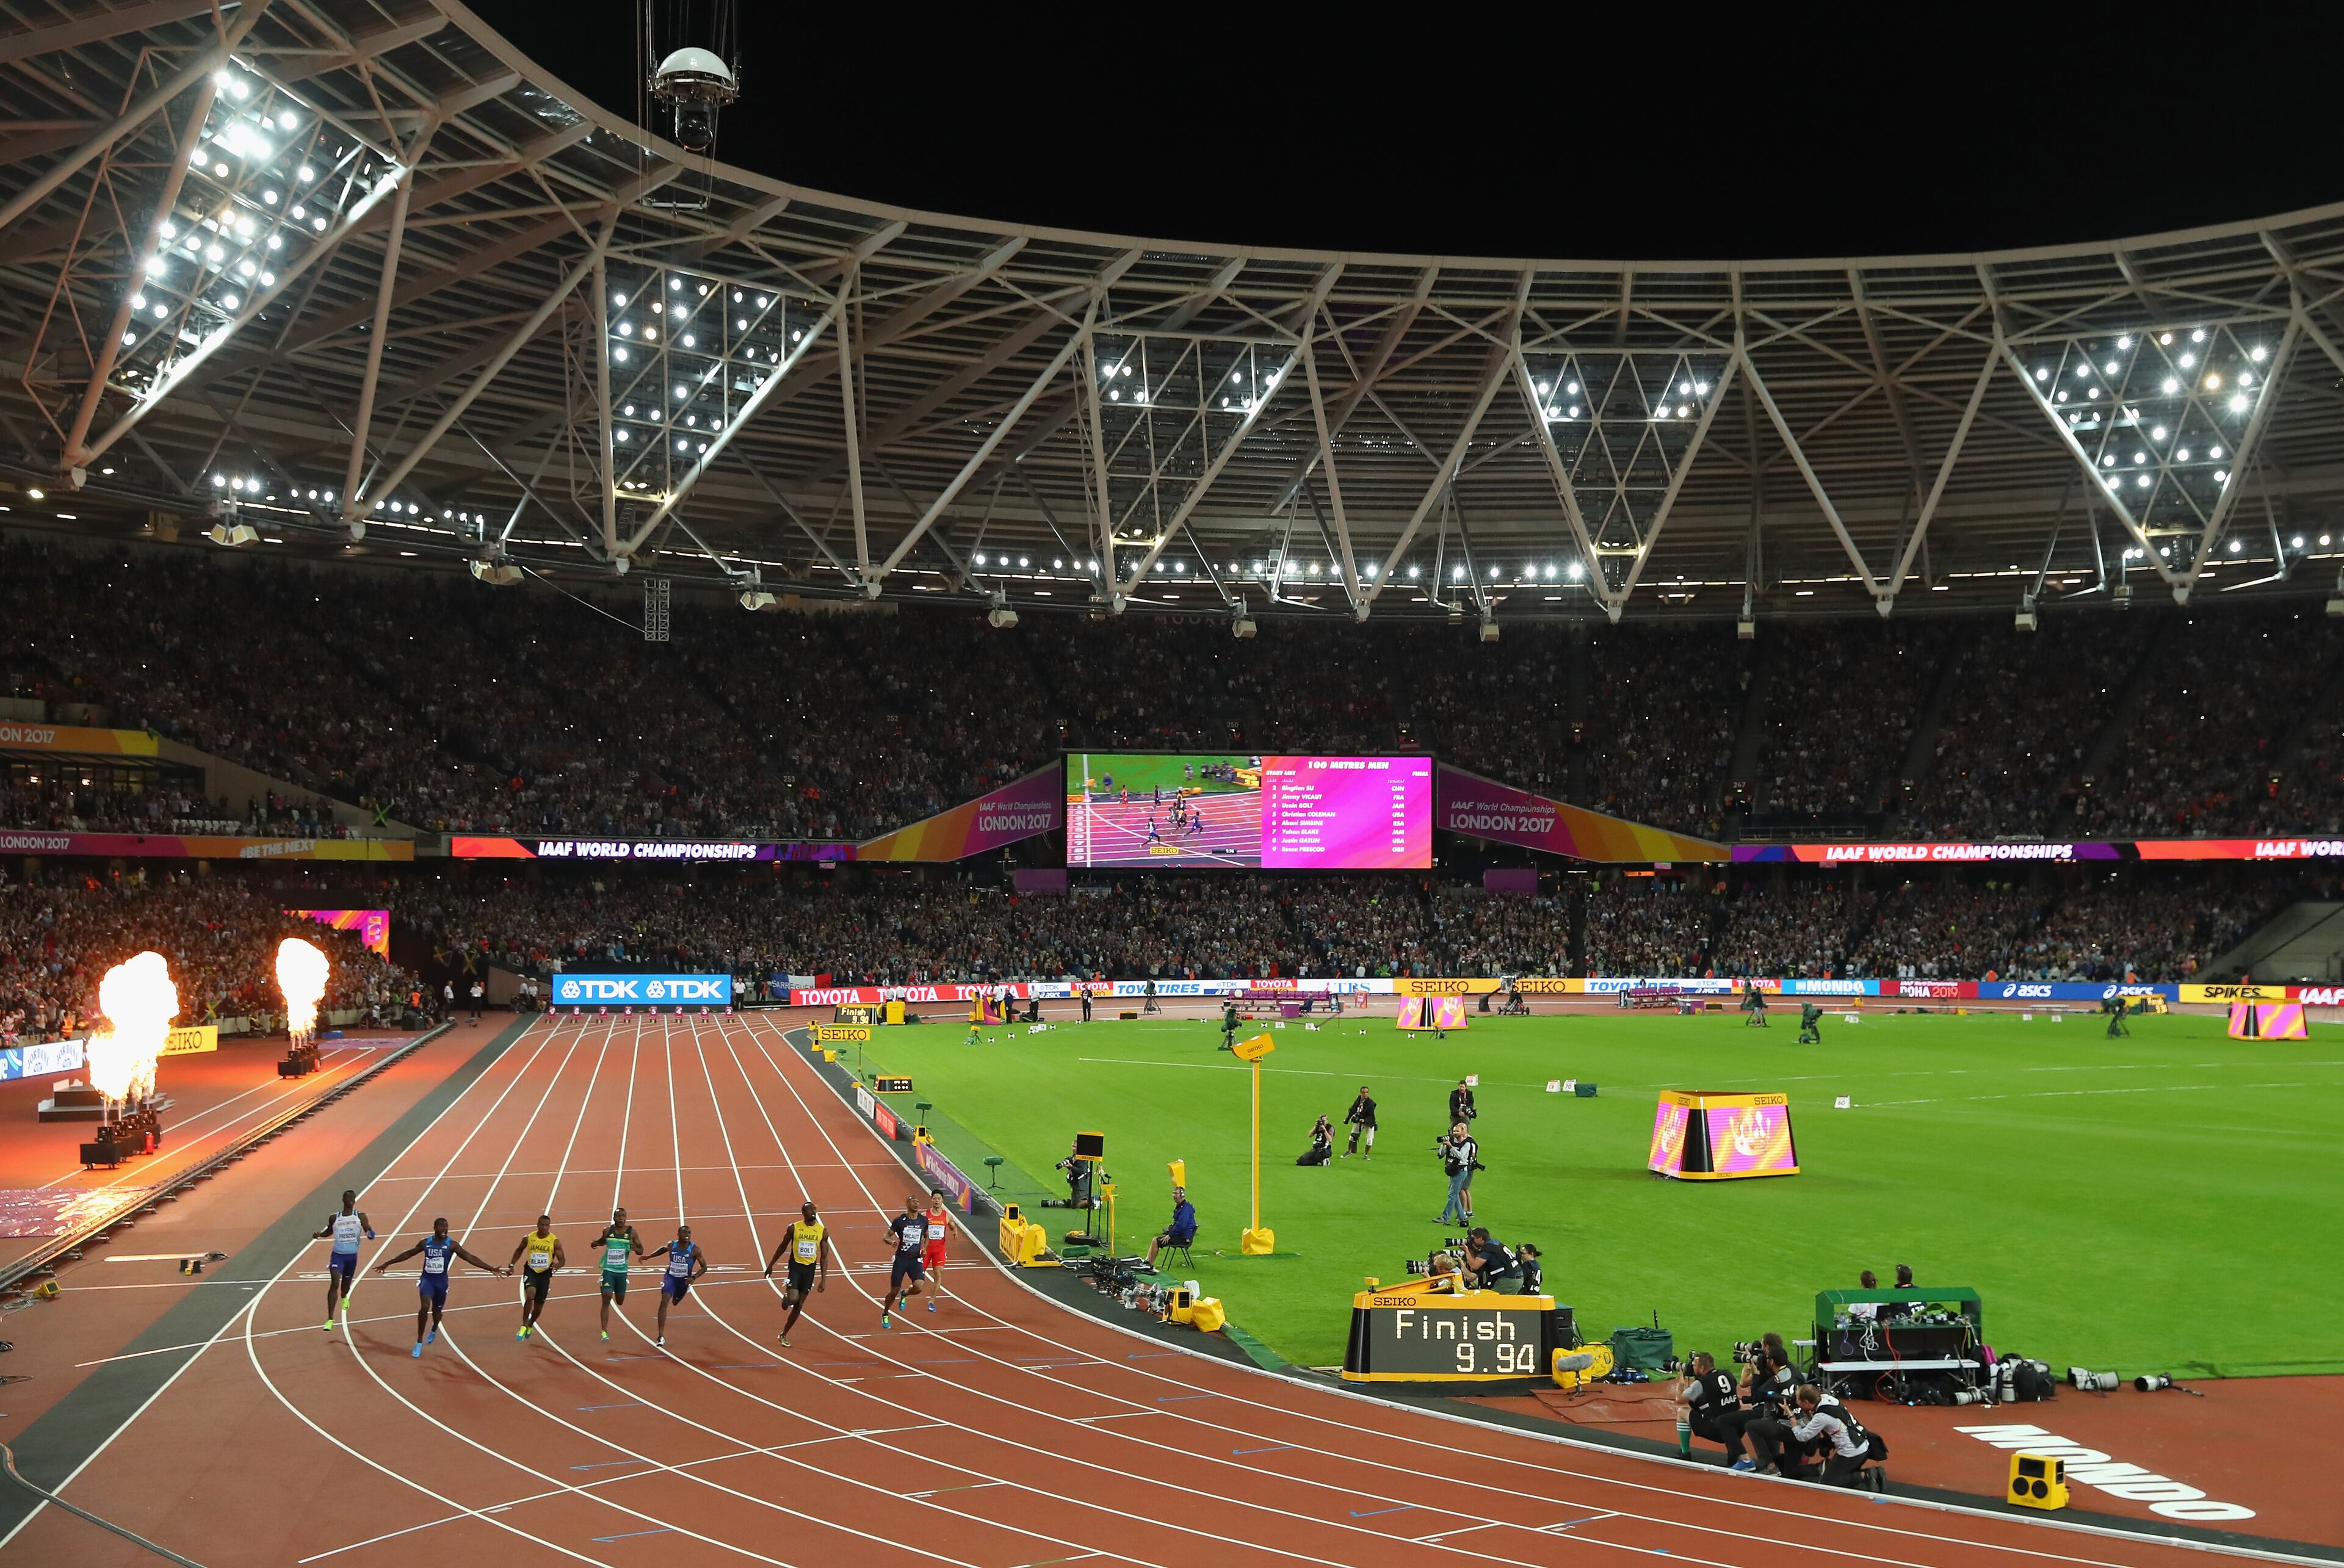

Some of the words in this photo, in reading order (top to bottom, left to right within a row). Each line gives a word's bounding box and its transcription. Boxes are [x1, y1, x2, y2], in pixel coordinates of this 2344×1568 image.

[24, 729, 56, 744] 2017
[980, 803, 996, 811] IAAF
[1014, 801, 1051, 811] Championships
[1452, 801, 1474, 810] IAAF
[1477, 802, 1498, 811] World
[1500, 803, 1556, 815] Championships
[979, 815, 1026, 831] LONDON
[1027, 814, 1051, 829] 2017
[1450, 814, 1516, 831] LONDON
[1519, 817, 1555, 833] 2017
[1, 836, 45, 849] LONDON
[46, 838, 70, 850] 2017
[262, 842, 283, 856] THE
[284, 839, 316, 853] NEXT
[2255, 842, 2296, 857] IAAF
[2300, 840, 2344, 856] WOR
[538, 842, 573, 857] IAAF
[576, 842, 630, 858] WORLD
[632, 843, 757, 859] CHAMPIONSHIPS
[1826, 847, 1864, 860] IAAF
[1867, 845, 1928, 859] WORLD
[1932, 844, 2073, 859] CHAMPIONSHIPS
[579, 980, 639, 999] TDK
[664, 980, 723, 999] TDK
[1157, 984, 1200, 994] TIRES
[1255, 980, 1293, 988] TOYOTA
[1412, 981, 1469, 992] SEIKO
[1590, 982, 1631, 991] TOYO
[1806, 980, 1864, 992] MONDO
[2017, 985, 2052, 997] asics
[799, 989, 861, 1005] TOYOTA
[1900, 986, 1931, 997] DOHA
[1932, 987, 1959, 997] 2019
[2204, 986, 2261, 998] SPIKES
[2298, 988, 2344, 1005] IAAF
[167, 1031, 202, 1050] EIKO
[822, 1030, 867, 1041] SEIKO
[1754, 1096, 1784, 1105] SEIKO
[428, 1248, 443, 1257] USA
[673, 1255, 686, 1263] USA
[1373, 1296, 1417, 1307] SEIKO
[1396, 1309, 1516, 1341] Finish
[1456, 1343, 1535, 1373] 9.94
[1717, 1375, 1732, 1393] 9
[1720, 1394, 1737, 1406] IAAF
[1953, 1424, 2257, 1520] MONDO
